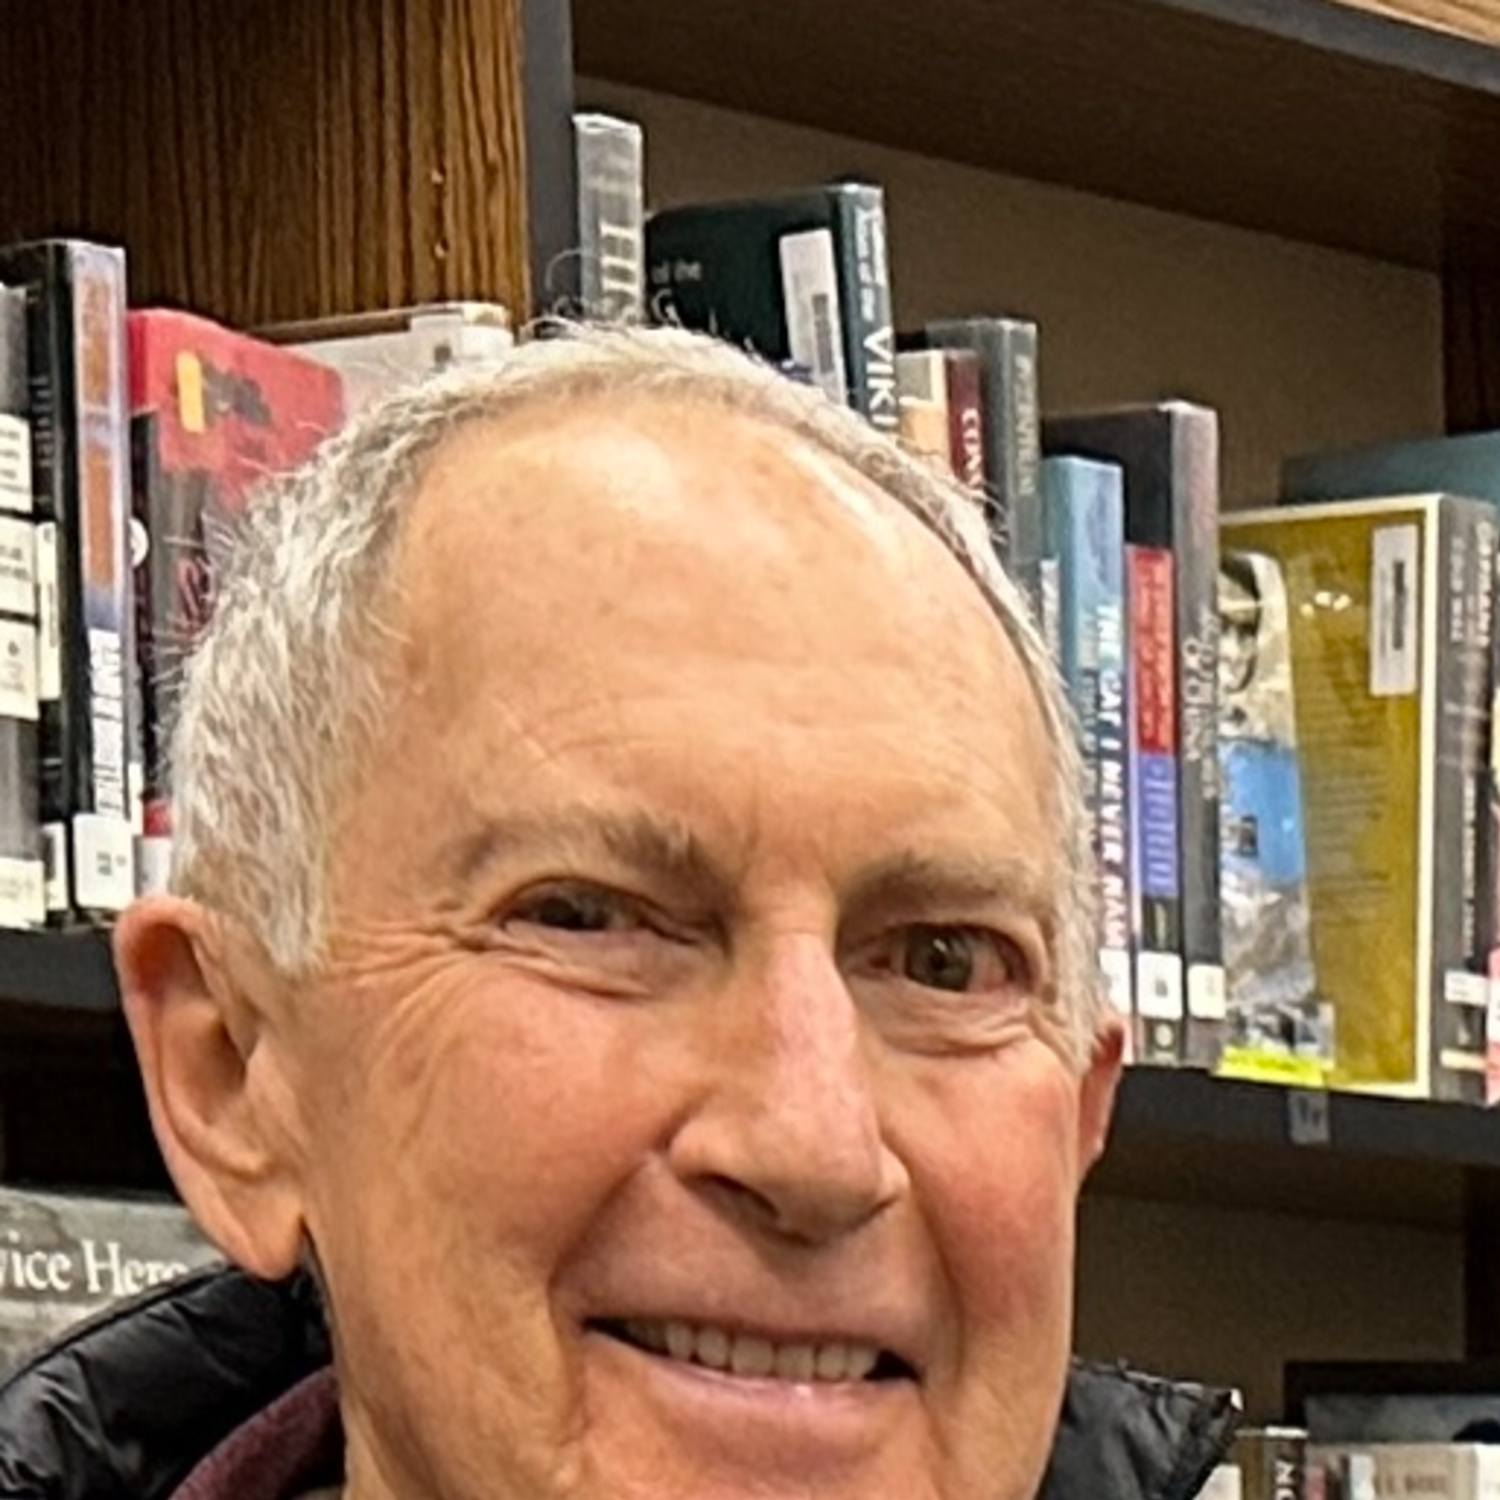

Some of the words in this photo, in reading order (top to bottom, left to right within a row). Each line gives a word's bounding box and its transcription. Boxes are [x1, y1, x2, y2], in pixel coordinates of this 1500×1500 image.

[863, 325, 900, 427] VIKI
[1097, 604, 1121, 660] THE
[1097, 669, 1122, 728] CAT
[1100, 759, 1124, 866] NEVER
[1101, 873, 1127, 950] NAM
